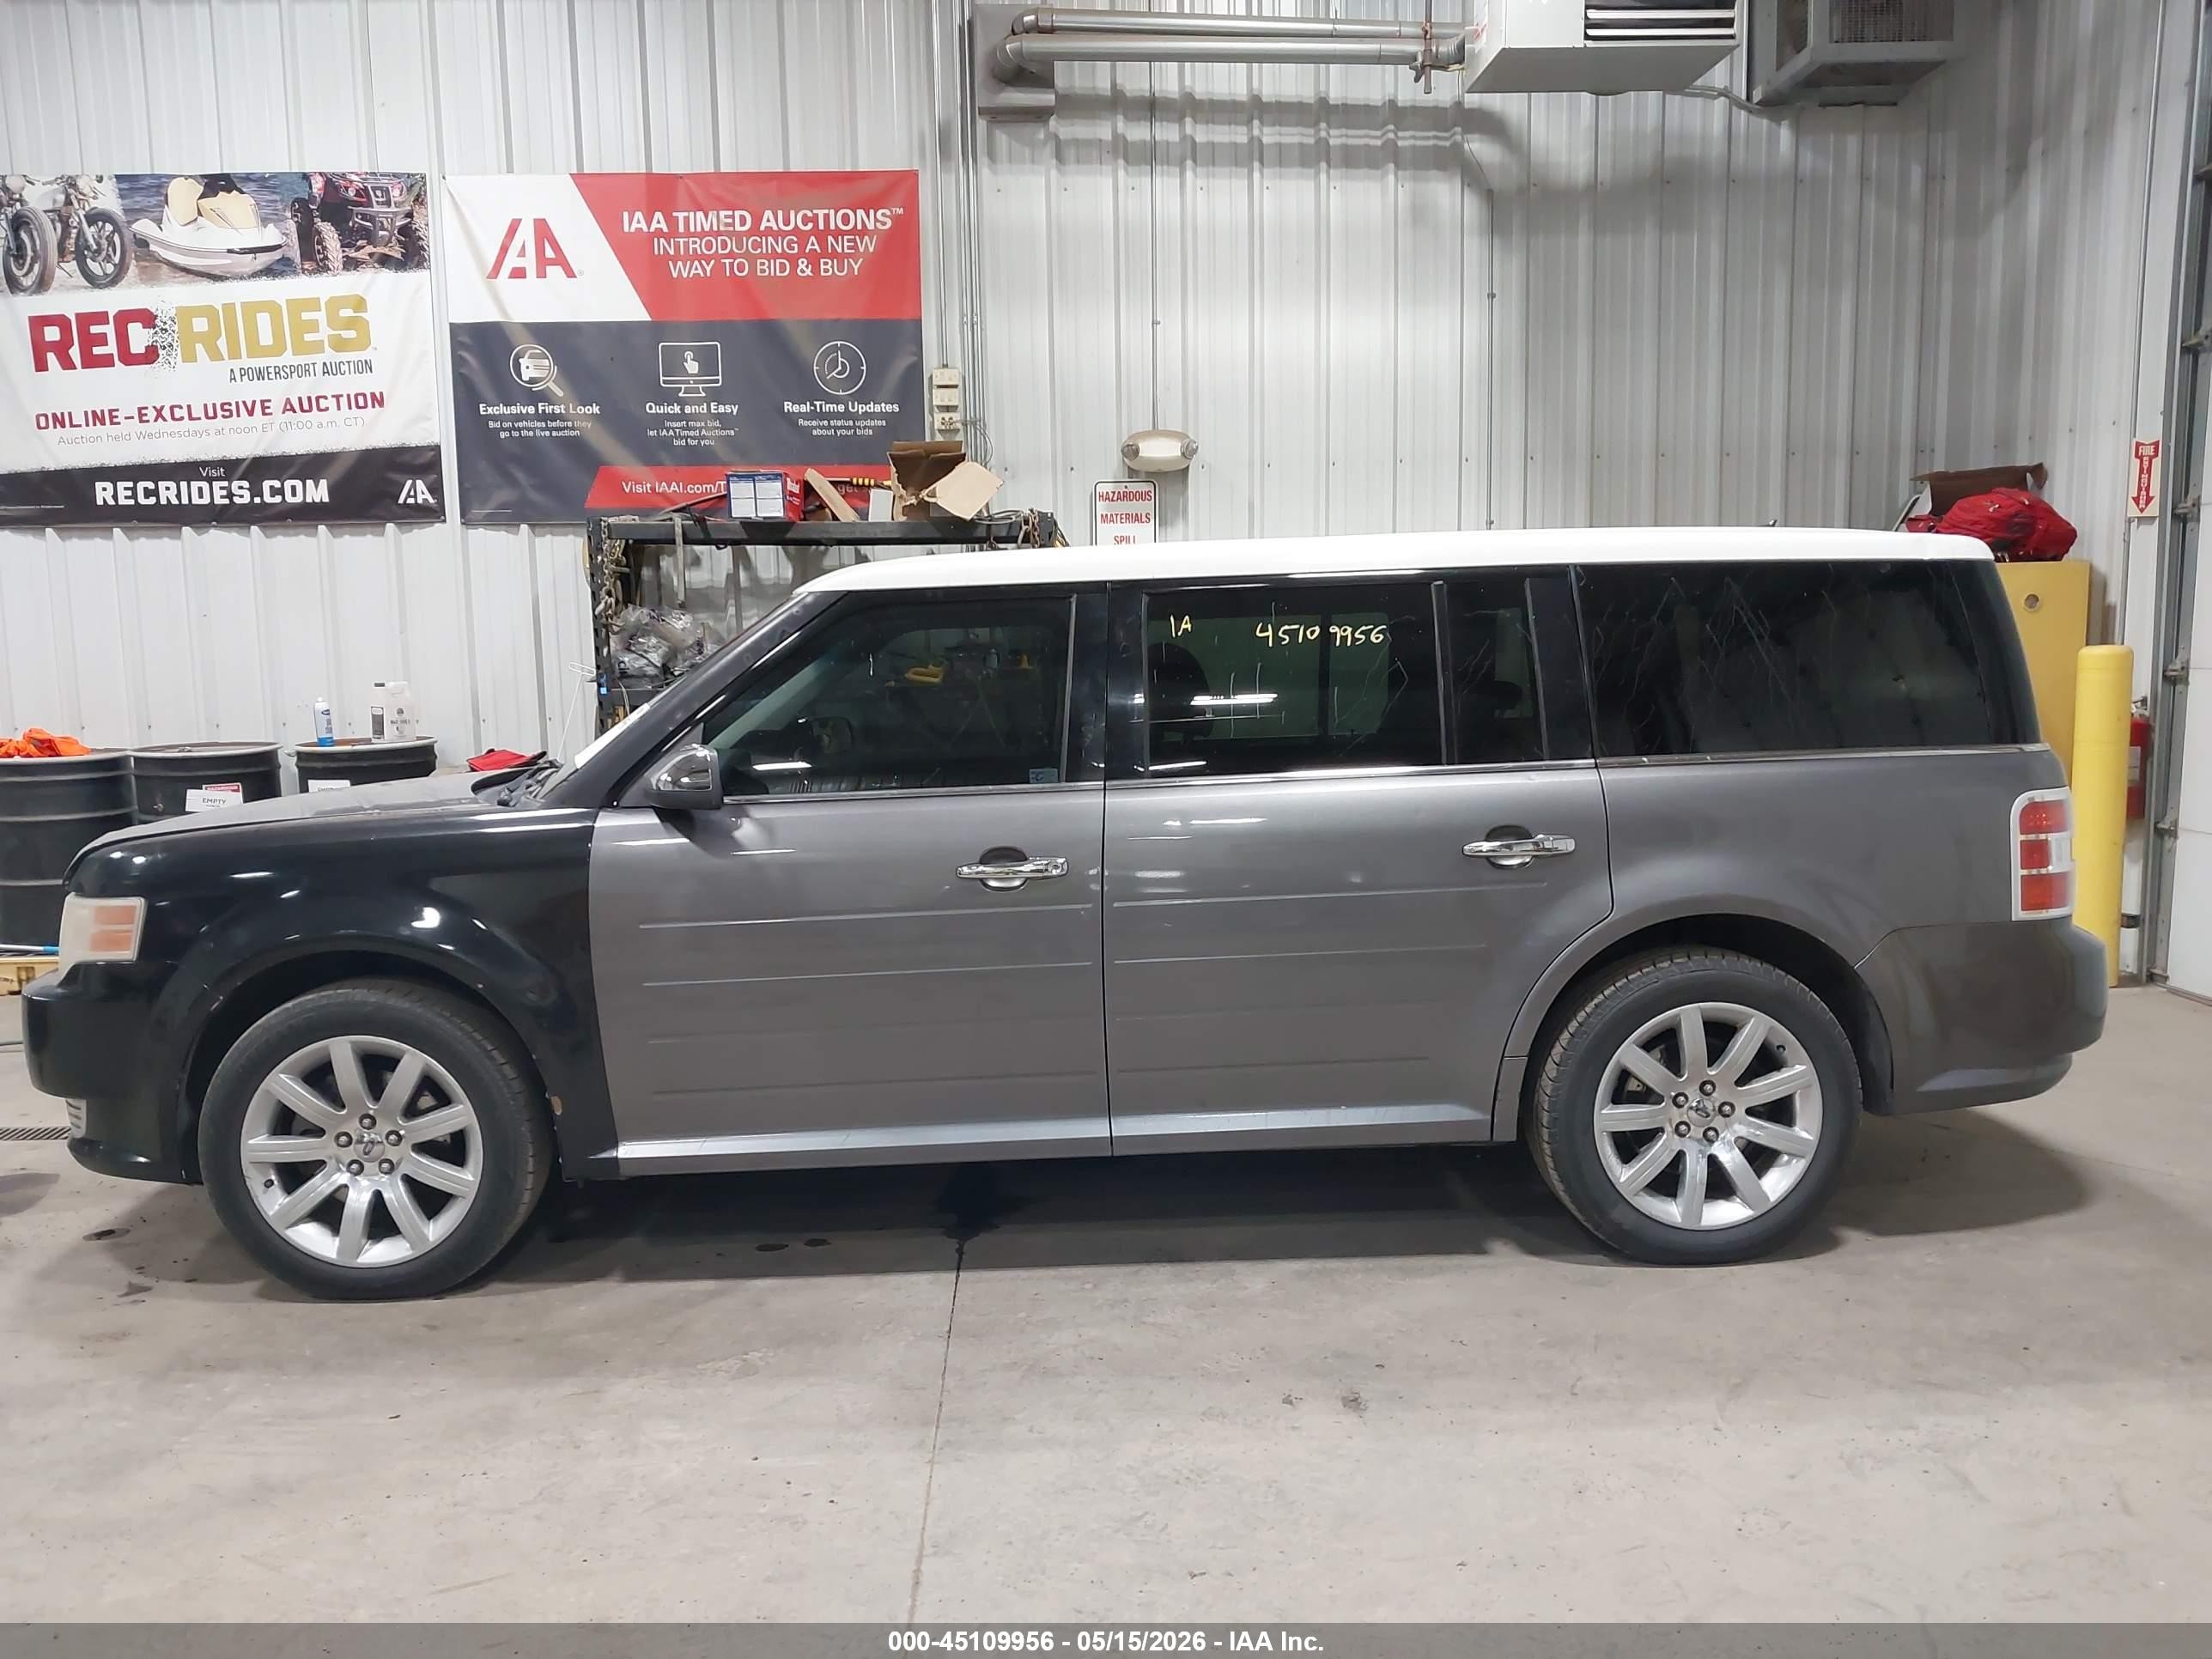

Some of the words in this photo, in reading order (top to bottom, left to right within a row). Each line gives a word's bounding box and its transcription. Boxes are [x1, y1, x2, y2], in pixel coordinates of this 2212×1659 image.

[623, 211, 669, 233] IAA
[672, 210, 752, 233] TIMED
[653, 235, 799, 255] INTRODUCING
[805, 235, 821, 253] A
[828, 234, 877, 253] NEW
[668, 259, 714, 278] WAY
[720, 258, 749, 276] TO
[757, 258, 790, 276] BID
[796, 258, 815, 276] &
[820, 258, 863, 276] BUY
[28, 307, 160, 373] REC
[175, 294, 372, 363] RIDES
[229, 368, 237, 383] A
[240, 362, 318, 382] POWERSPORT
[322, 358, 374, 378] AUCTION
[35, 398, 273, 430] ONLINE-EXCLUSIVE
[282, 392, 385, 415] AUCTION
[479, 403, 535, 415] Exclusive
[538, 403, 566, 414] First
[569, 403, 600, 415] Look
[646, 403, 682, 413] Quick
[684, 403, 707, 413] and
[710, 403, 738, 415] Easy
[784, 401, 845, 412] Real-Time
[848, 401, 899, 414] Updates
[574, 420, 592, 429] they
[708, 419, 722, 428] bid,
[855, 419, 886, 428] updates
[58, 433, 103, 446] Auction
[106, 430, 131, 443] held
[136, 426, 210, 441] Wednesdays
[214, 427, 225, 436] at
[228, 425, 258, 435] noon
[261, 422, 275, 433] ET
[279, 419, 313, 433] (11:00
[317, 420, 340, 429] a.m.
[344, 416, 365, 428] CT)
[199, 465, 226, 477] Visit
[94, 478, 330, 505] RECRIDES.COM
[622, 481, 651, 494] Visit
[1098, 490, 1152, 502] HAZARDOUS
[1100, 513, 1151, 525] MATERIALS
